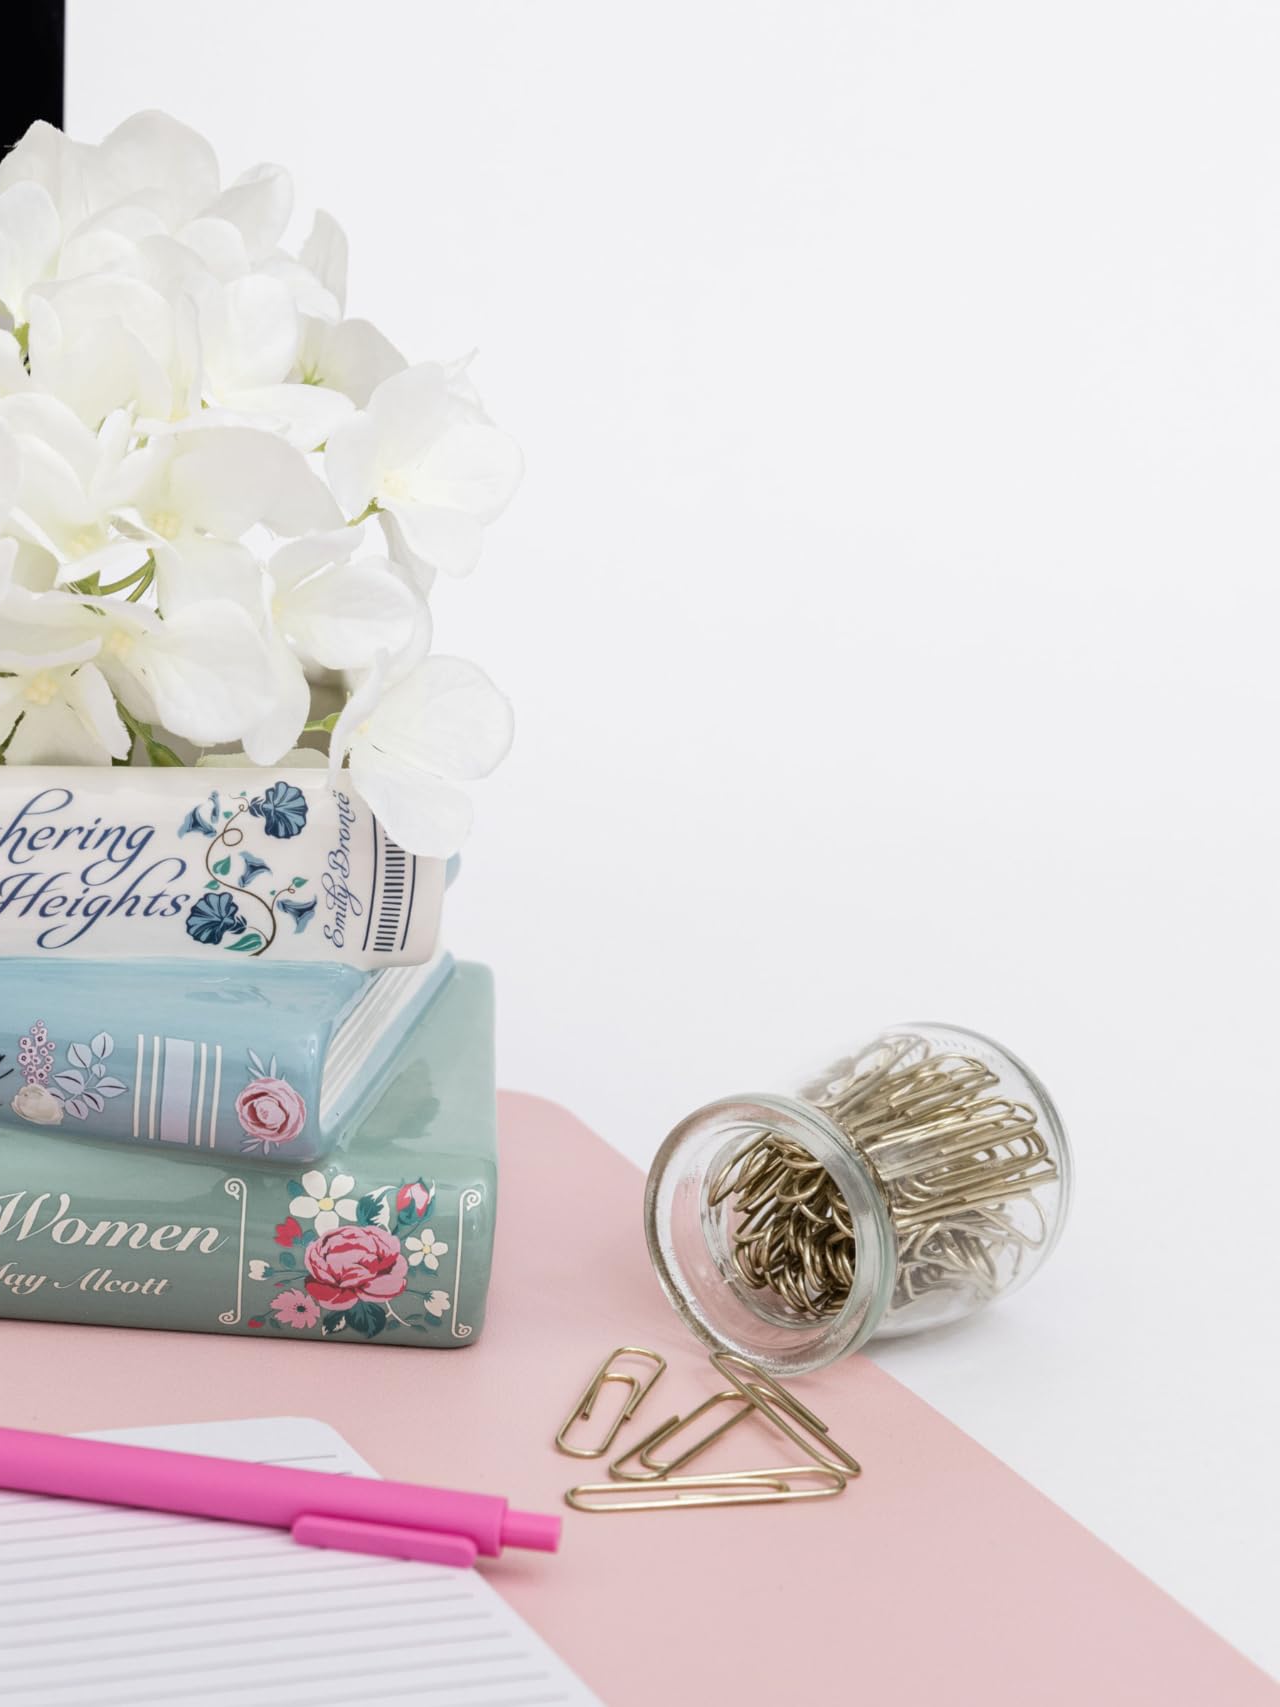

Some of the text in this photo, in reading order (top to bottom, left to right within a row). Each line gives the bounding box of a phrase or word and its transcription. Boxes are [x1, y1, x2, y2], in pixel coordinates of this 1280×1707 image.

[321, 789, 363, 948] Emily Brontë
[54, 1267, 172, 1297] Alcott
